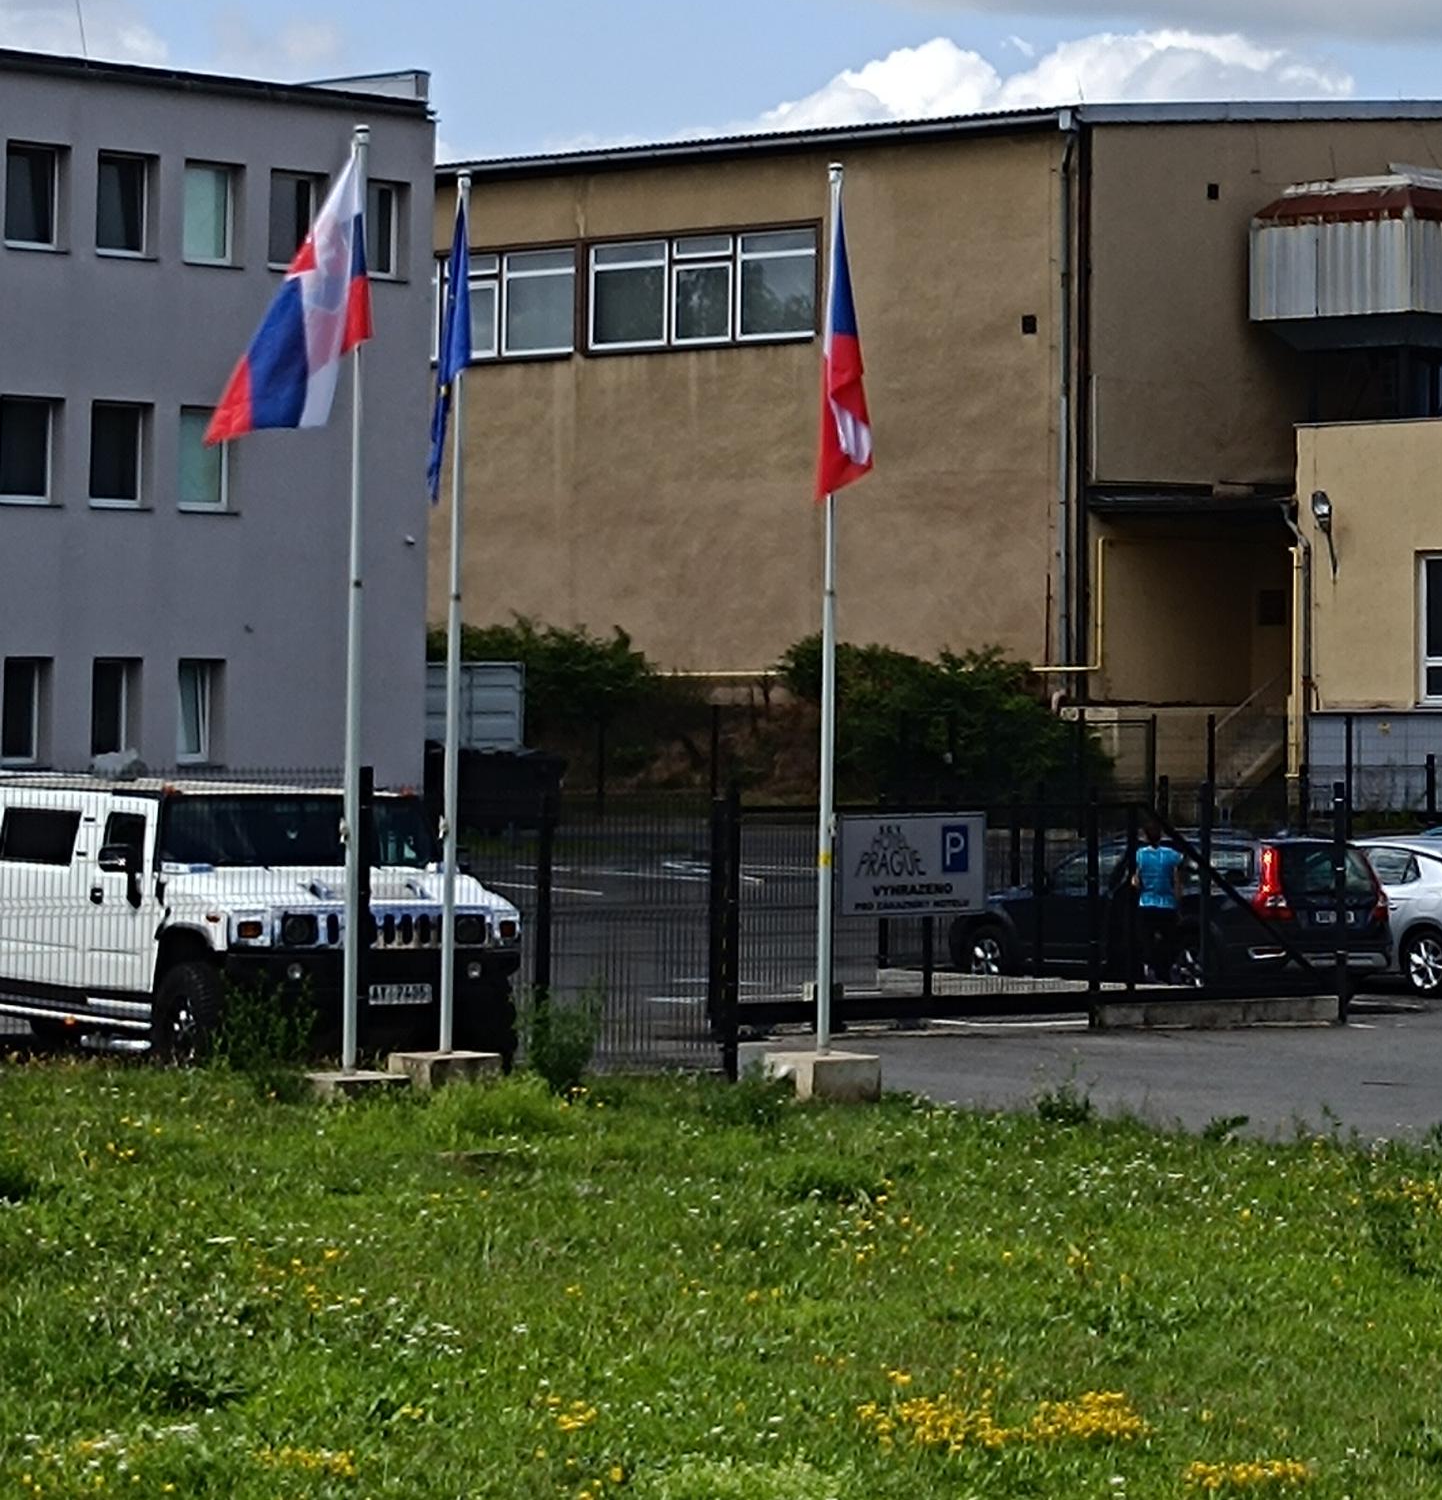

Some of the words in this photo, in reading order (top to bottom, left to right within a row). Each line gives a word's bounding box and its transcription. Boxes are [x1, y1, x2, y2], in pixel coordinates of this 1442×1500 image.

[854, 849, 927, 877] PRAGUE
[945, 831, 966, 867] P
[872, 882, 954, 896] VYHRAZENO
